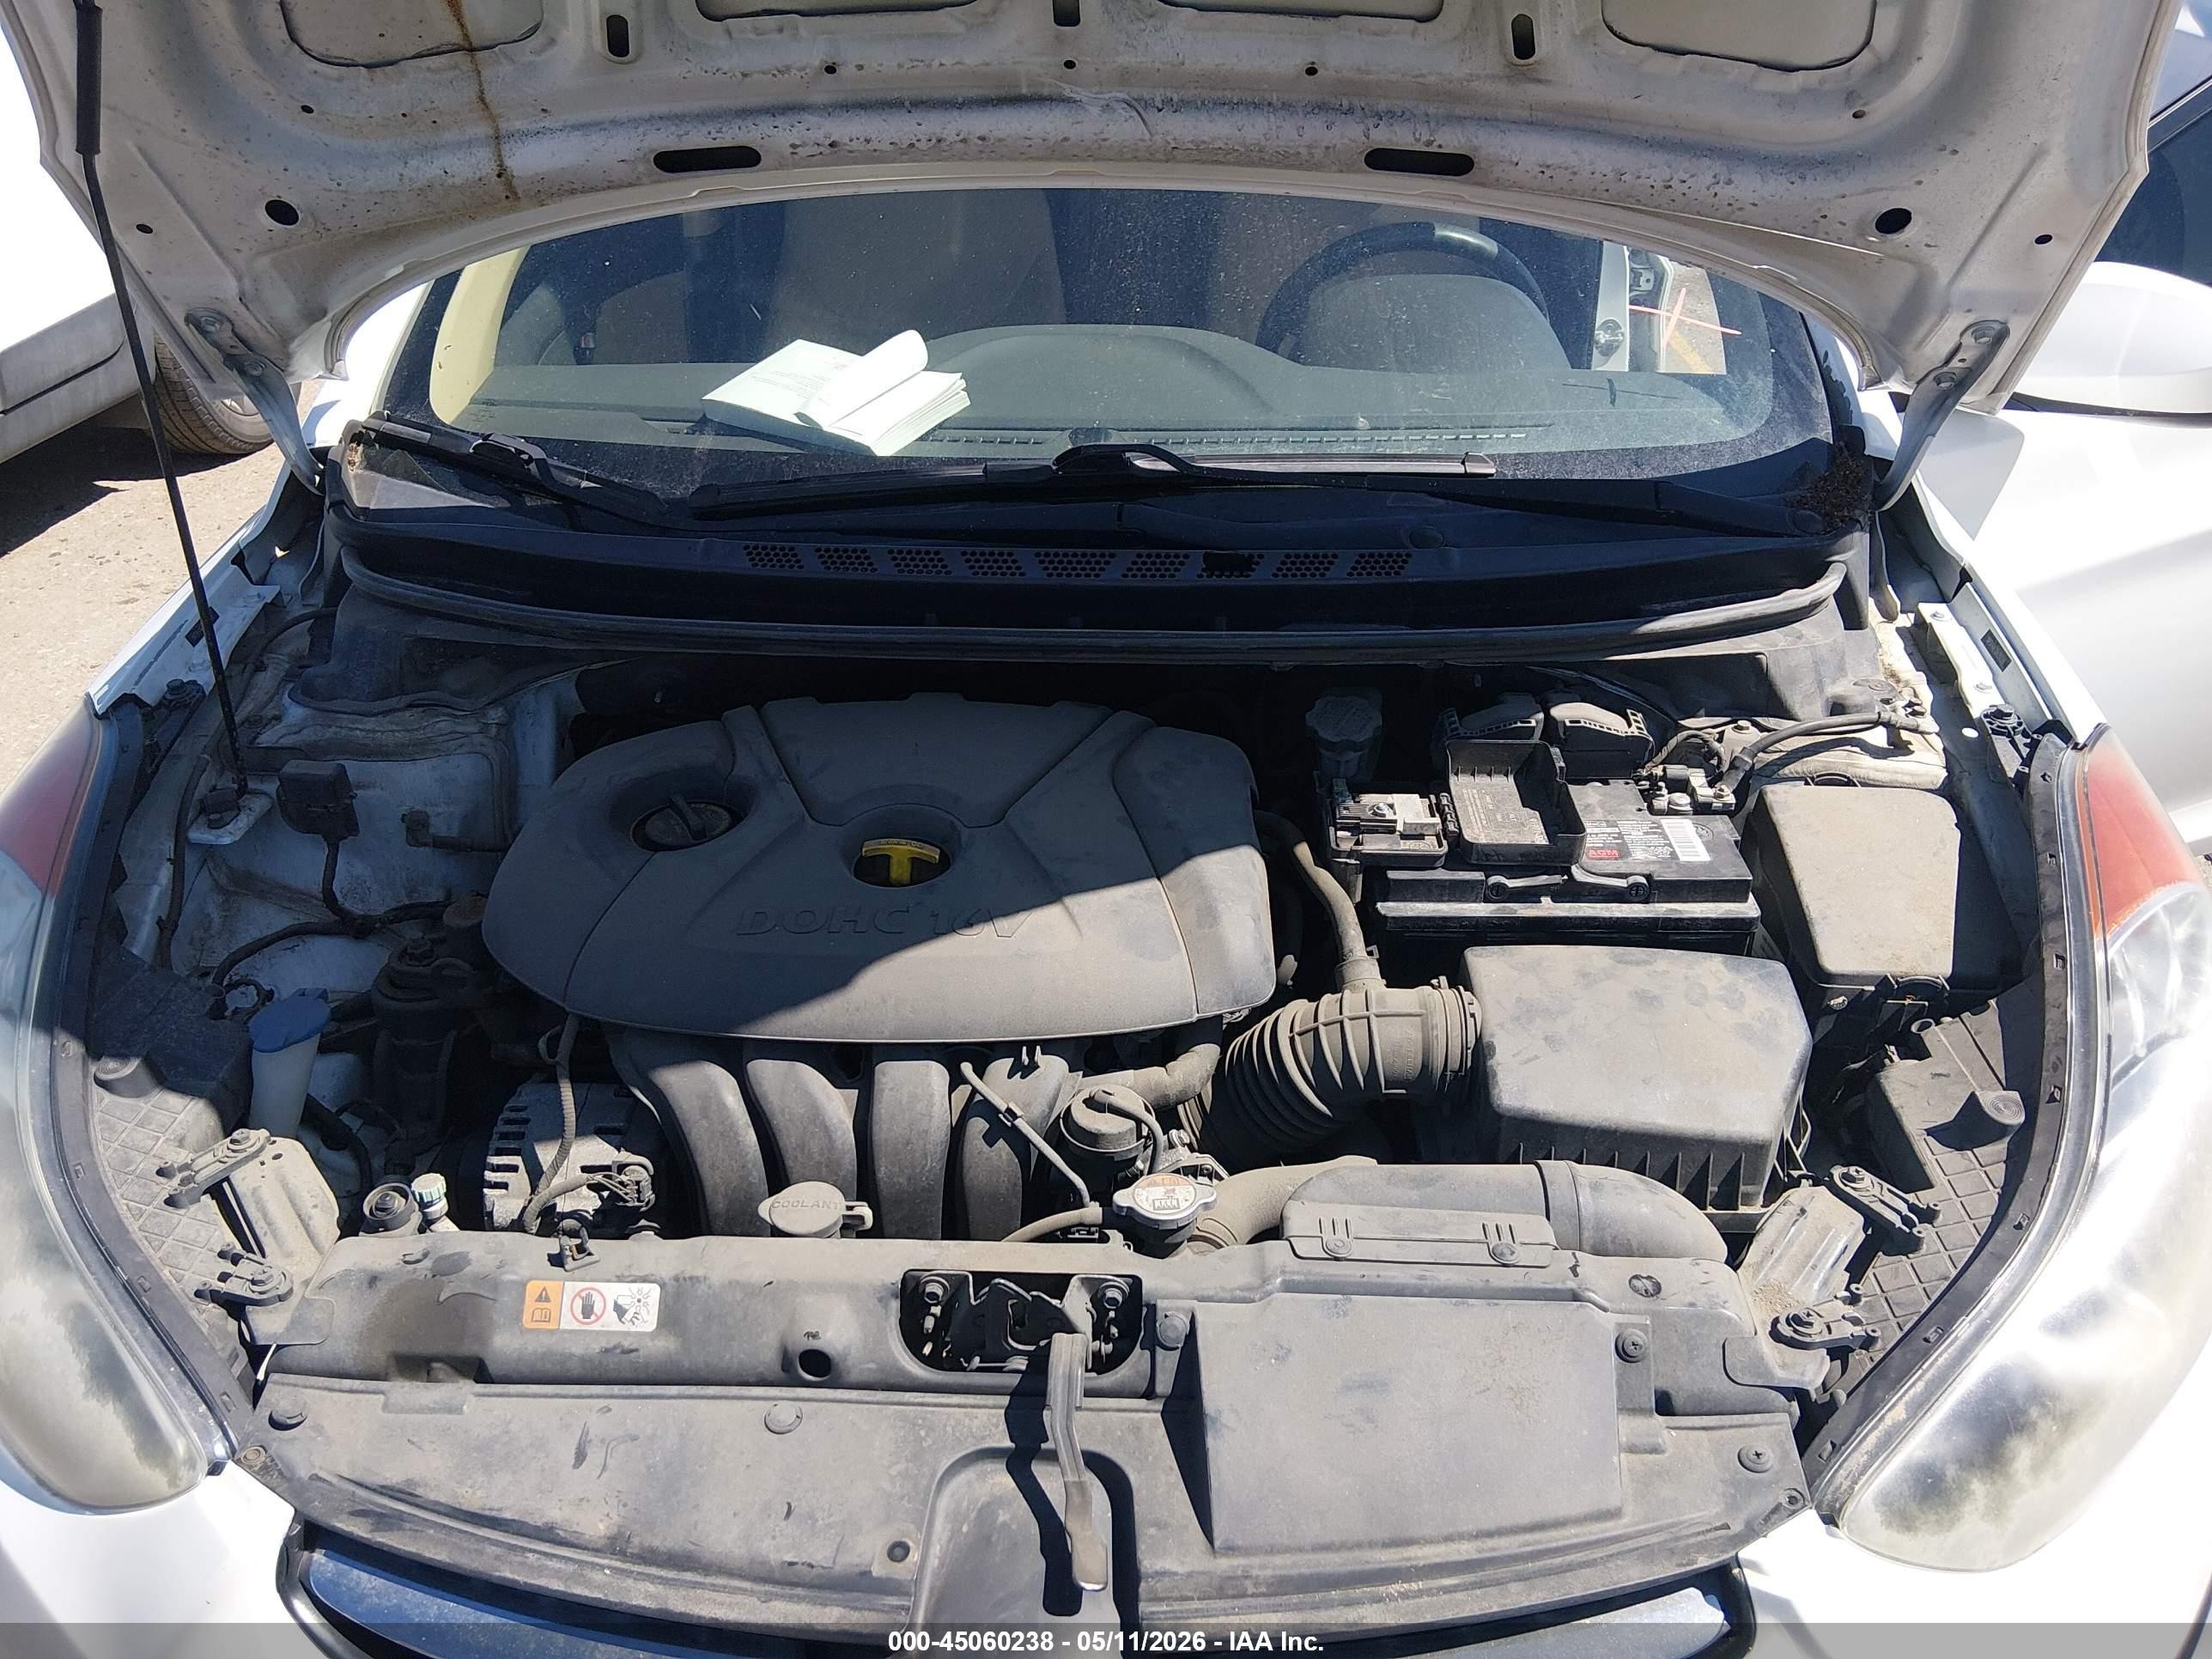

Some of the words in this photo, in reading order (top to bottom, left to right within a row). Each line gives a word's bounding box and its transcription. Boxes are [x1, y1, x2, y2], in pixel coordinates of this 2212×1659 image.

[1588, 848, 1620, 859] AGM
[736, 905, 912, 936] DOHC
[930, 907, 1033, 939] 16V
[771, 1199, 842, 1210] COOLANT
